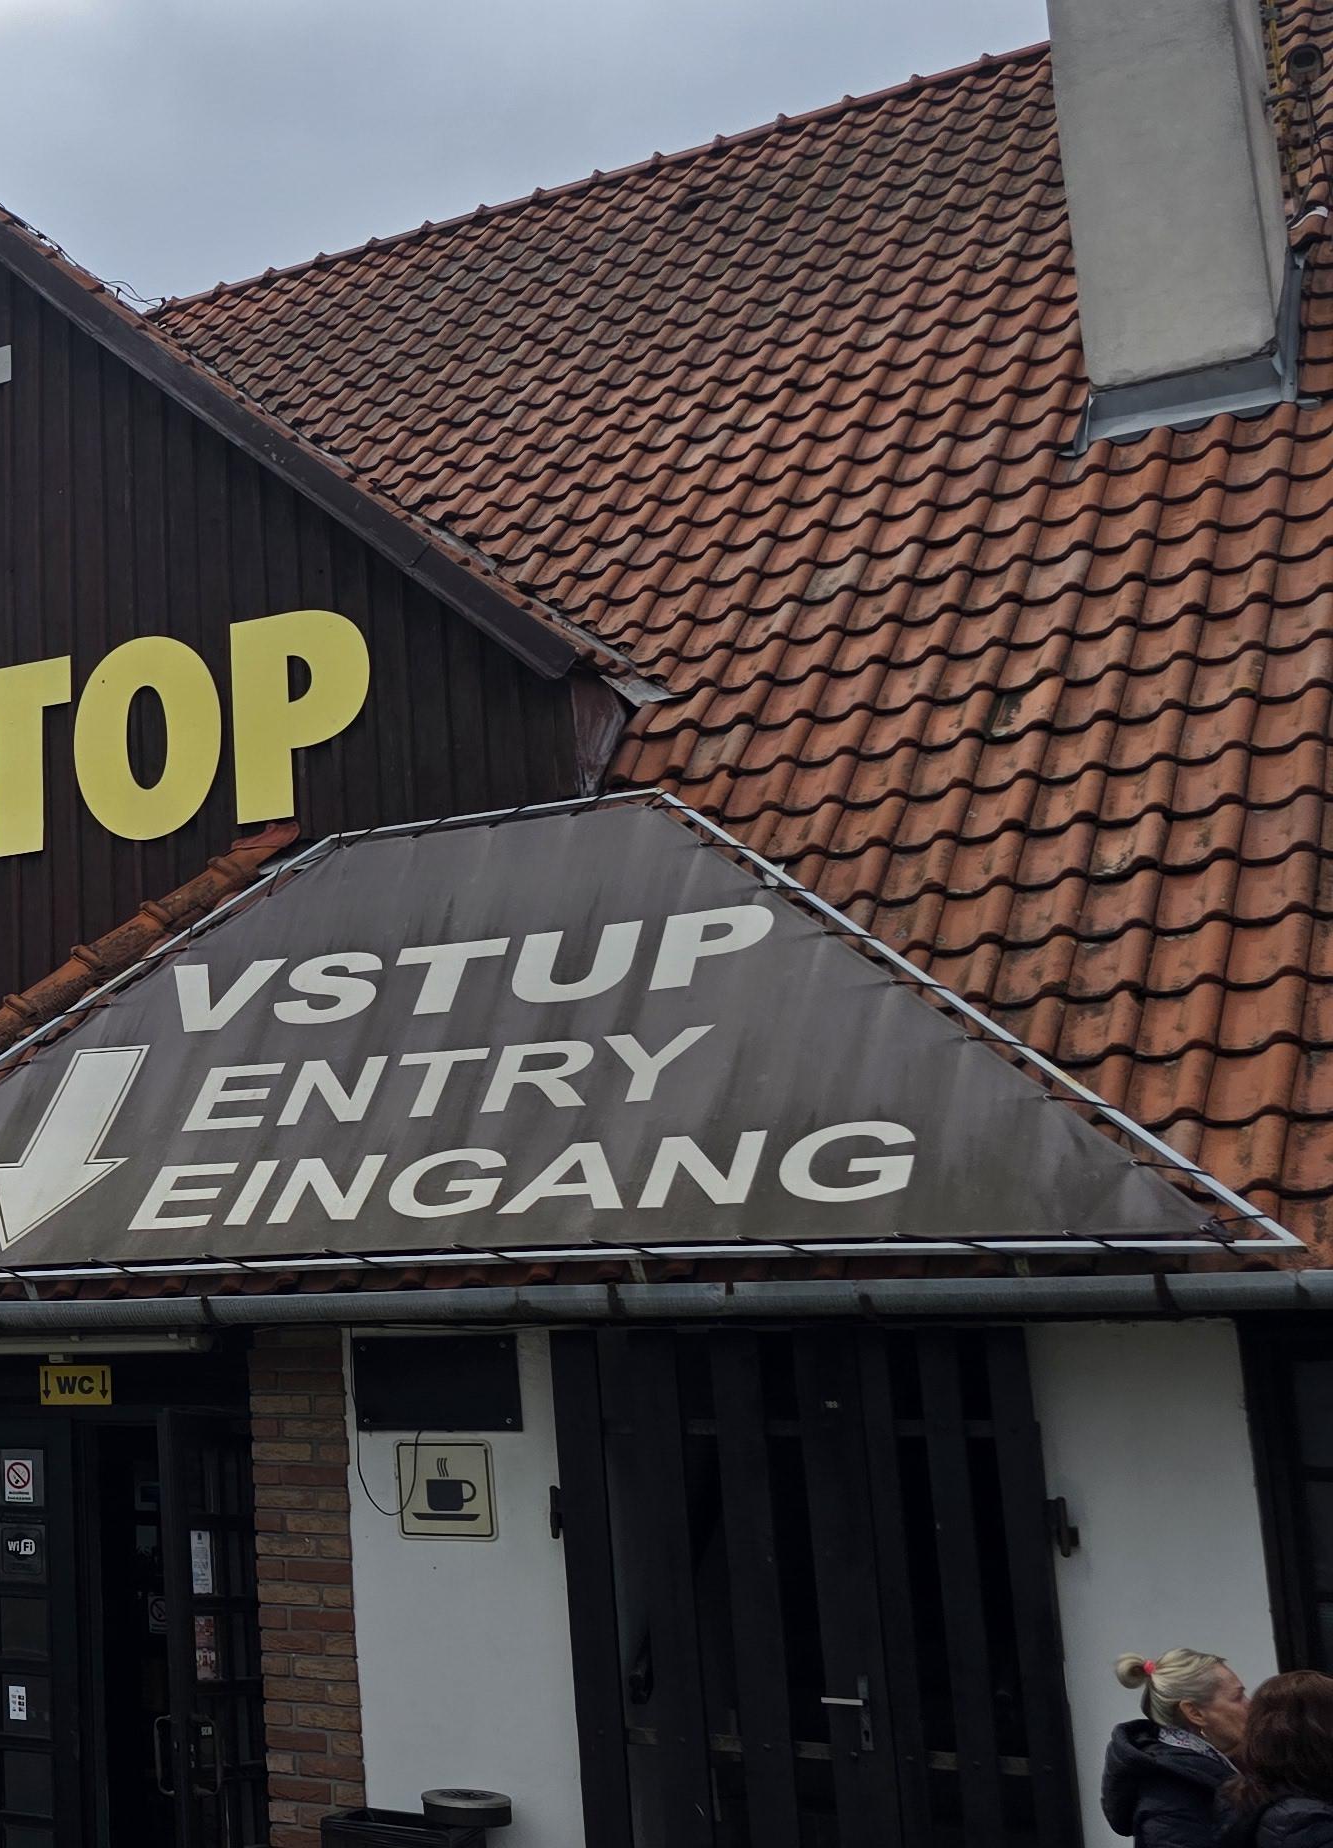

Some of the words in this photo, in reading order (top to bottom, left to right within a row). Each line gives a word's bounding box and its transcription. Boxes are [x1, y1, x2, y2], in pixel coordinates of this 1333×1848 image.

[173, 904, 774, 1033] VSTUP
[181, 1024, 715, 1131] ENTRY
[128, 1120, 917, 1231] EINGANG
[56, 1376, 95, 1394] WC
